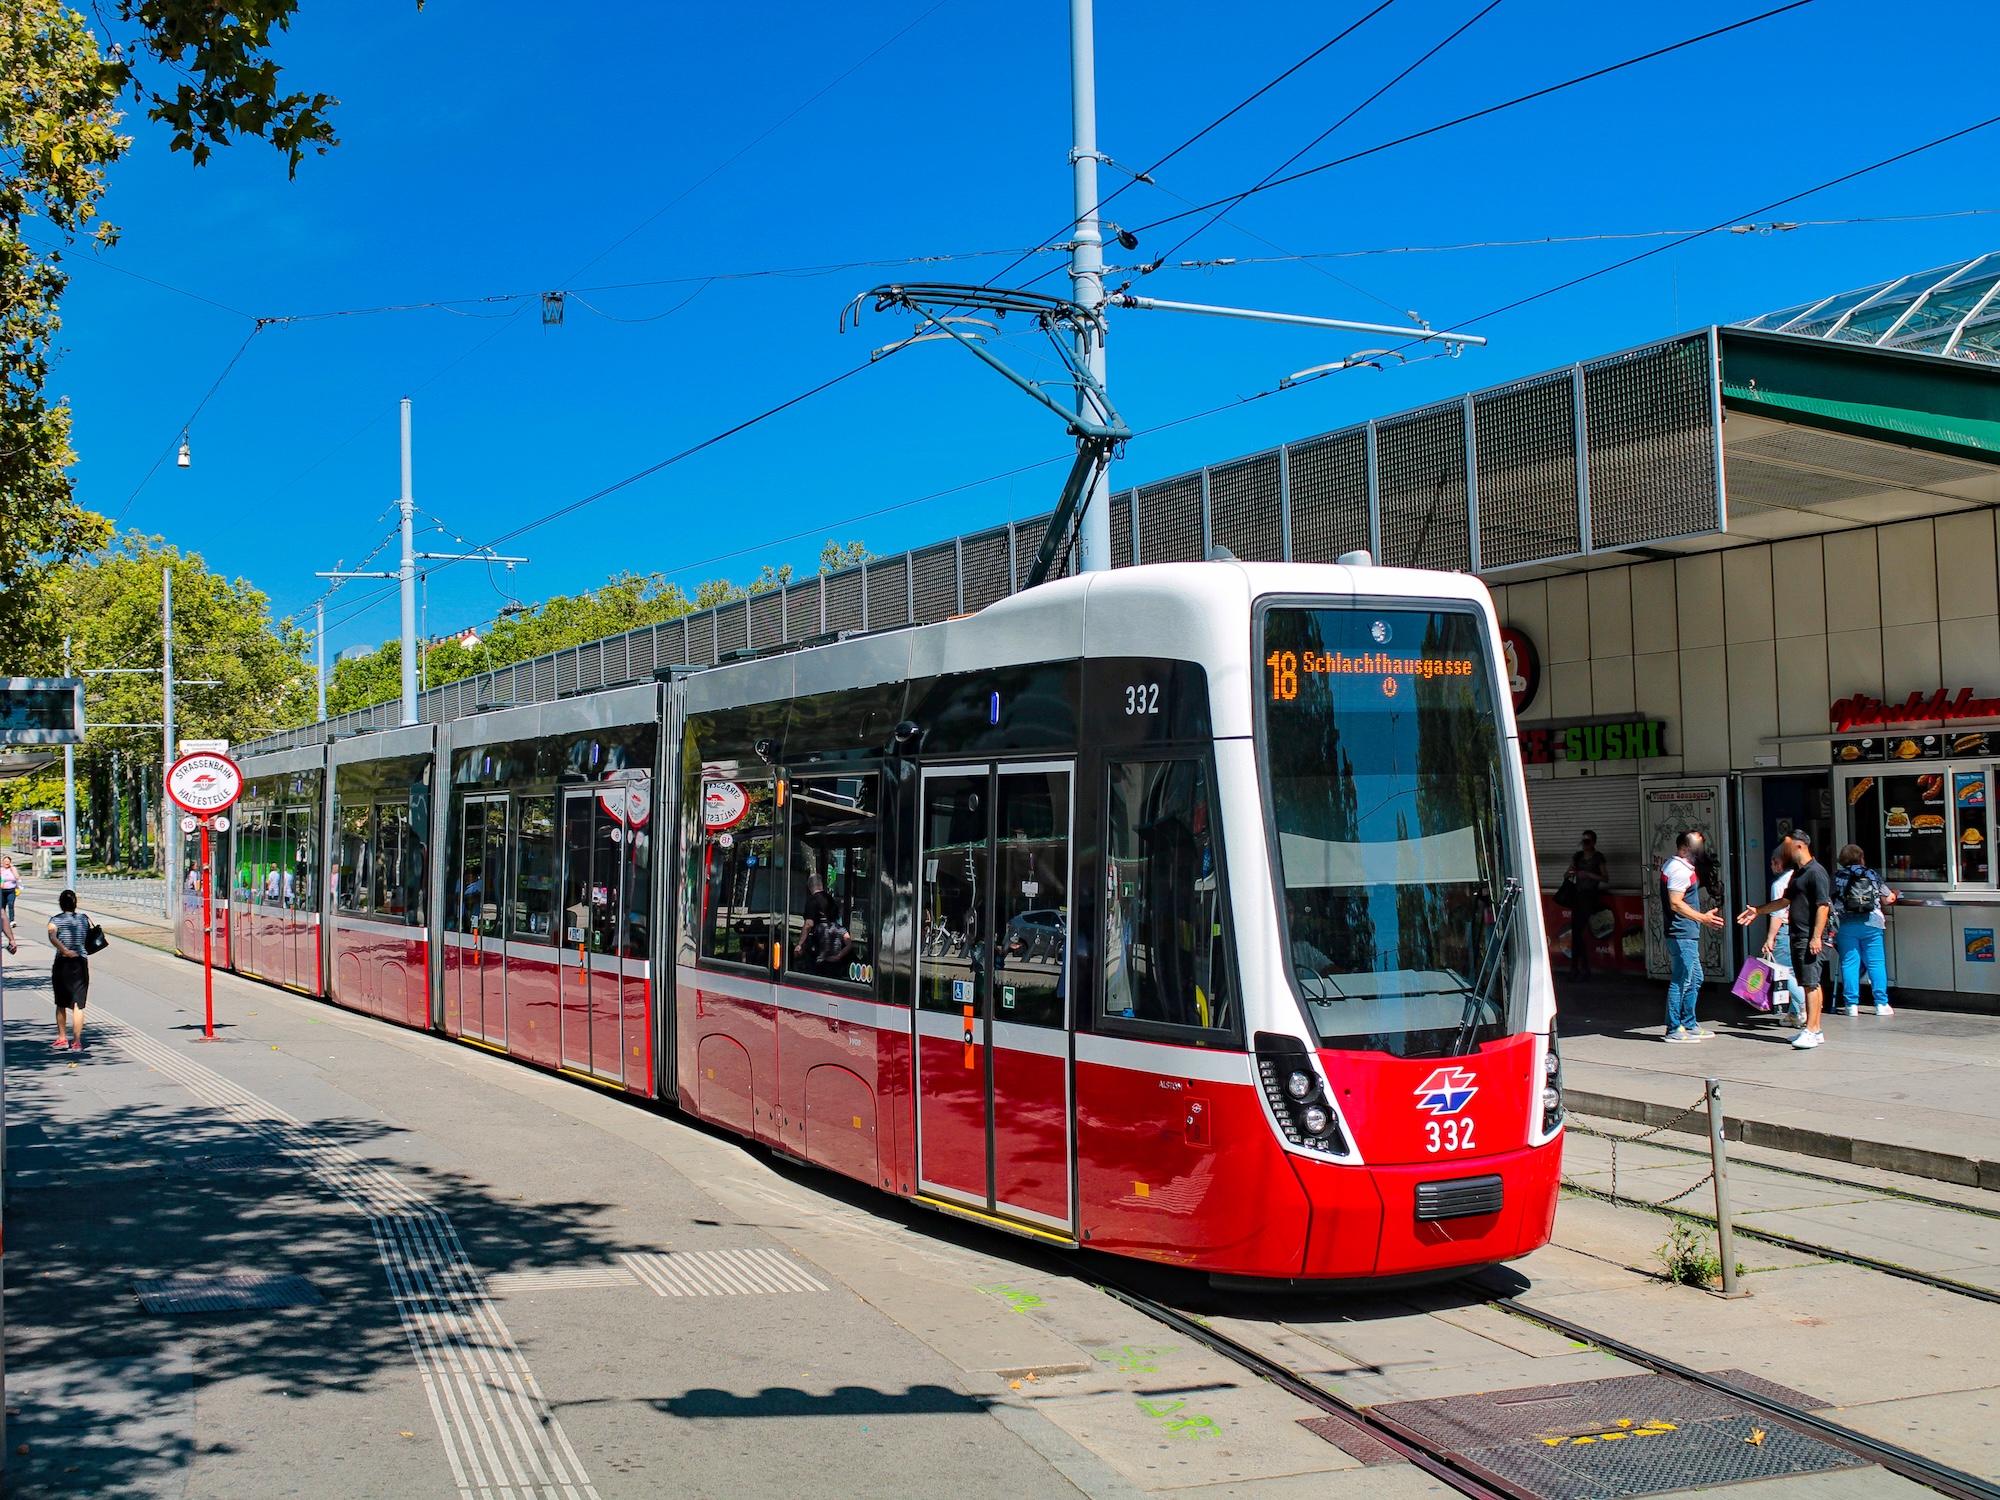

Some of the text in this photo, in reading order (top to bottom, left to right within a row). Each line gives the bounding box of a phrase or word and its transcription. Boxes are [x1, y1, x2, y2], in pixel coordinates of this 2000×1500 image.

[1266, 650, 1472, 700] 18 Schlachthausgasse
[1125, 683, 1159, 715] 332
[175, 759, 234, 780] STRASSENBAHN
[178, 788, 231, 806] HALTESTELLE
[183, 820, 194, 829] 18
[219, 820, 226, 829] 6
[1425, 1117, 1476, 1153] 332
